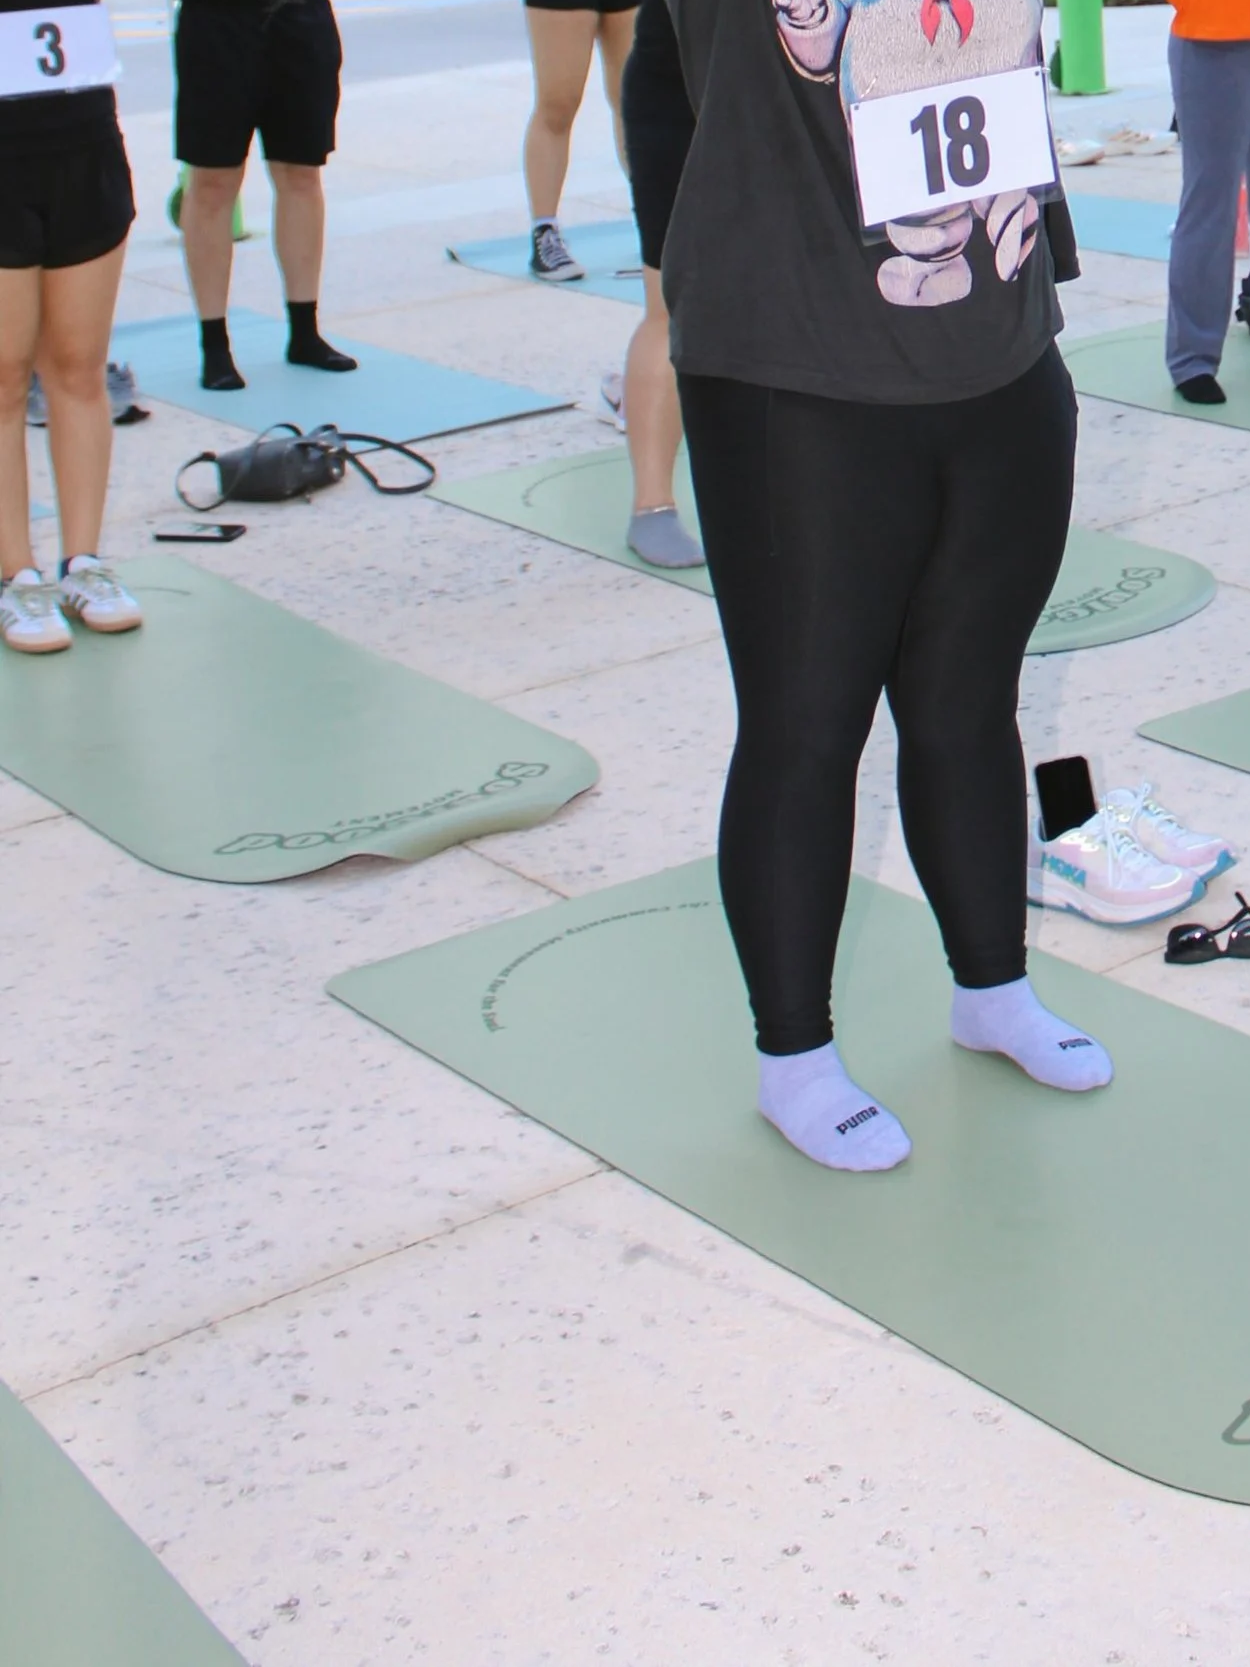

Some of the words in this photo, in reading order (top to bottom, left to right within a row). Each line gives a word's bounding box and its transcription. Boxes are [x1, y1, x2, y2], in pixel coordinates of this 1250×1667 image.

[33, 21, 66, 78] 3
[909, 95, 991, 196] 18
[1058, 1037, 1094, 1051] PUMA
[835, 1105, 879, 1135] PUMA
